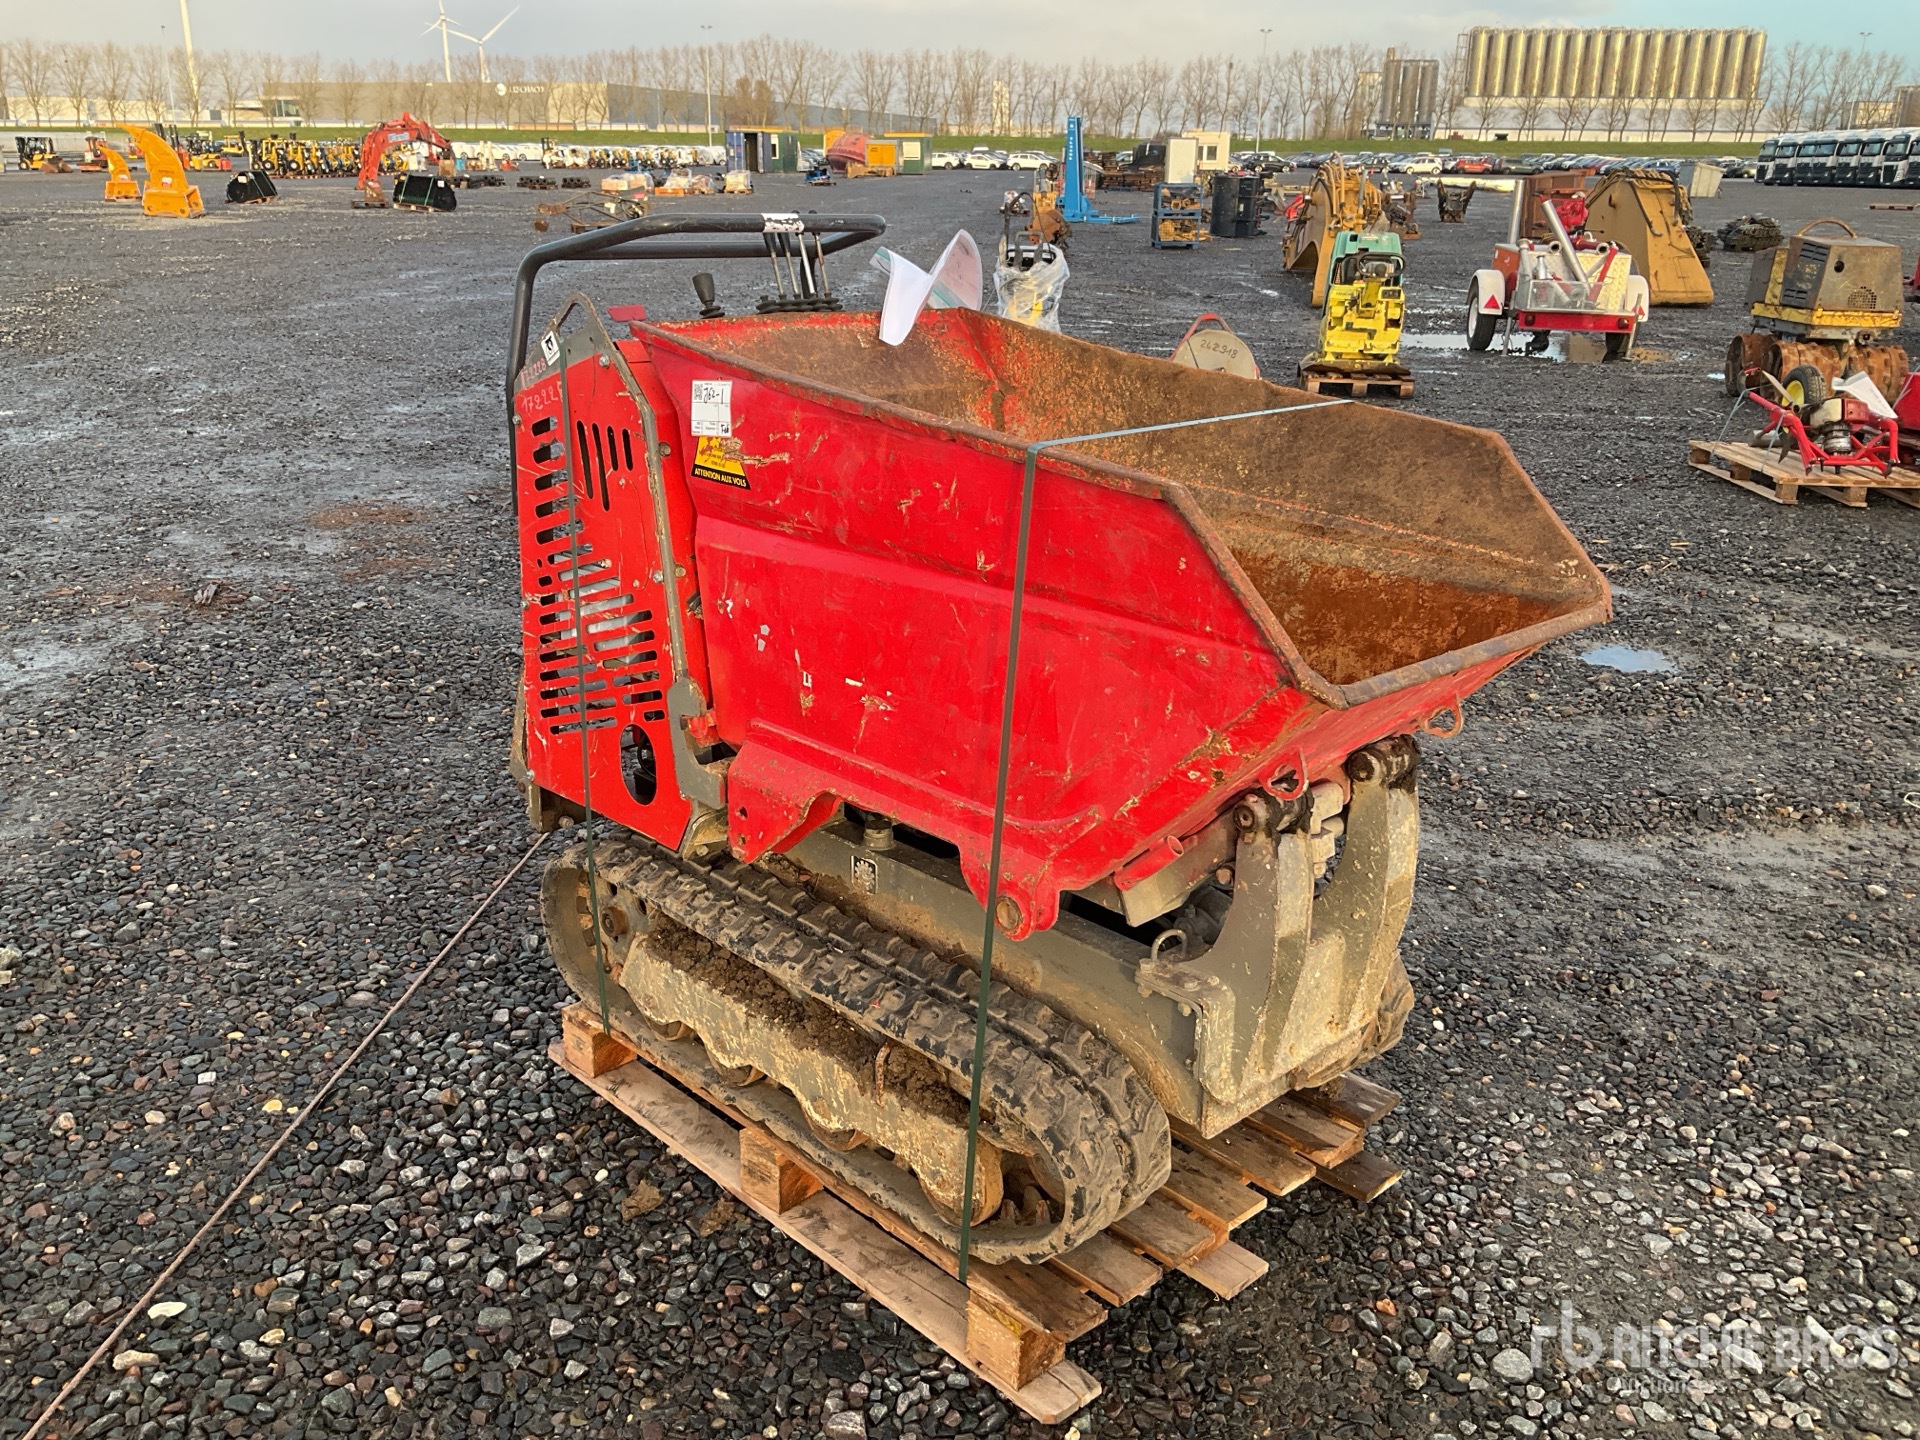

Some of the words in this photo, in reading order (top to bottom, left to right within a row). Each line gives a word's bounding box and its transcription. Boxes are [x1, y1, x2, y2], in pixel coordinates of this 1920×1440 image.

[1200, 339, 1238, 358] 242918
[694, 467, 721, 481] ATTENTION
[721, 474, 732, 484] AUX
[732, 477, 746, 487] VOLS
